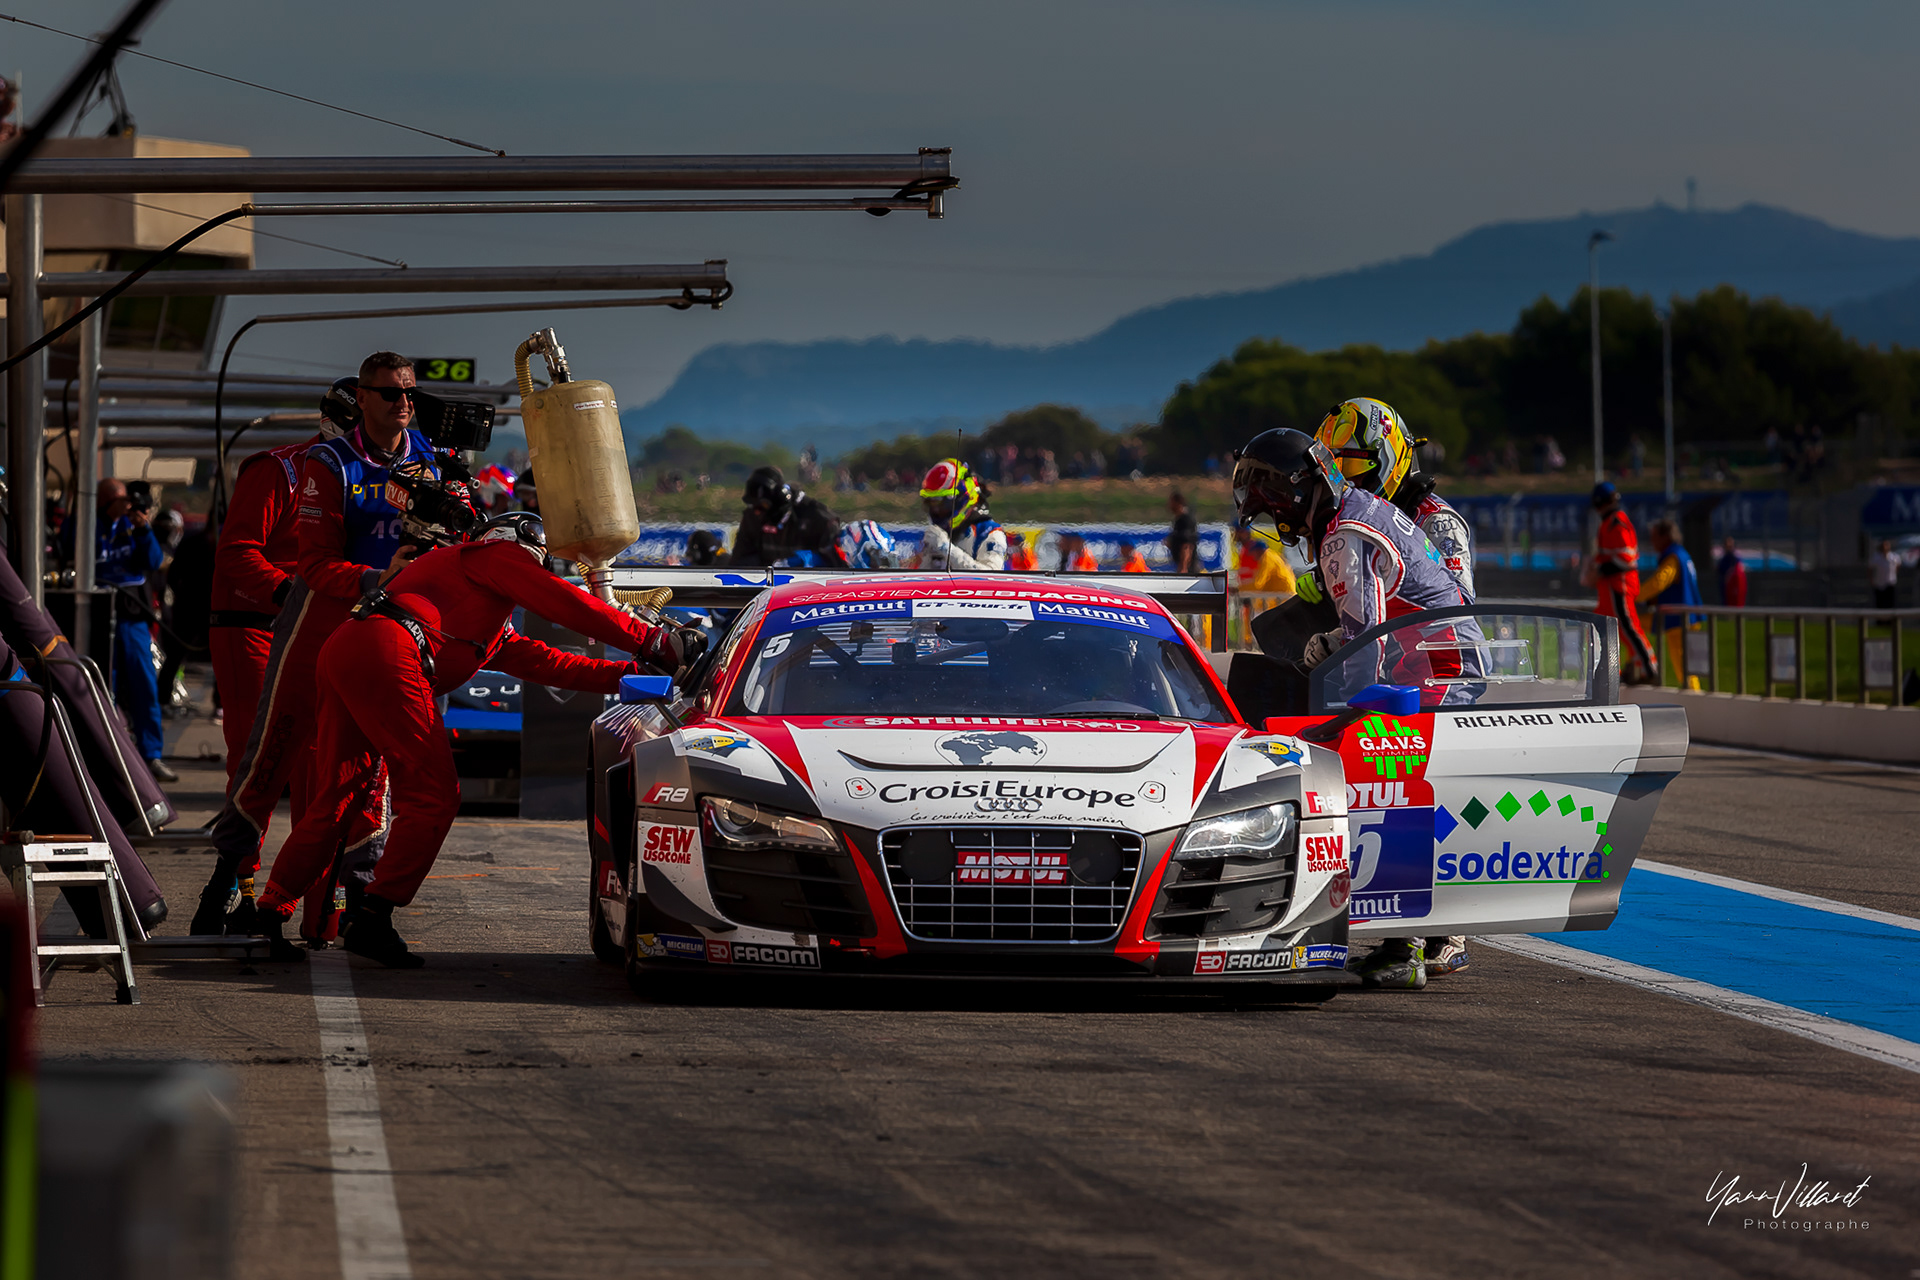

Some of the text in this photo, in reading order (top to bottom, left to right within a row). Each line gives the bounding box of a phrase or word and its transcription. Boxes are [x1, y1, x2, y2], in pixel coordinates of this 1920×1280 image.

[426, 360, 471, 381] 36
[387, 484, 407, 505] TV 04
[791, 600, 906, 622] Matmut
[1038, 603, 1149, 627] Matmut
[762, 632, 794, 658] 5
[1454, 711, 1627, 729] RICHARD MILLE
[1359, 736, 1427, 750] G.A.V.S
[654, 787, 690, 803] R8
[878, 780, 1136, 808] CroisiEurope
[1347, 782, 1410, 808] OTUL
[644, 826, 696, 852] SEW
[1306, 835, 1343, 861] SEW
[643, 849, 692, 865] USOCOME
[1348, 810, 1386, 893] 5
[1437, 841, 1603, 881] sodextra
[960, 855, 1068, 881] MOTUL
[1307, 859, 1348, 873] USOCOME
[1350, 894, 1402, 915] tmut
[666, 940, 704, 952] MICHELIN
[733, 948, 816, 965] FACOM
[1309, 950, 1346, 960] MICHELIN
[1227, 951, 1292, 969] FACOM
